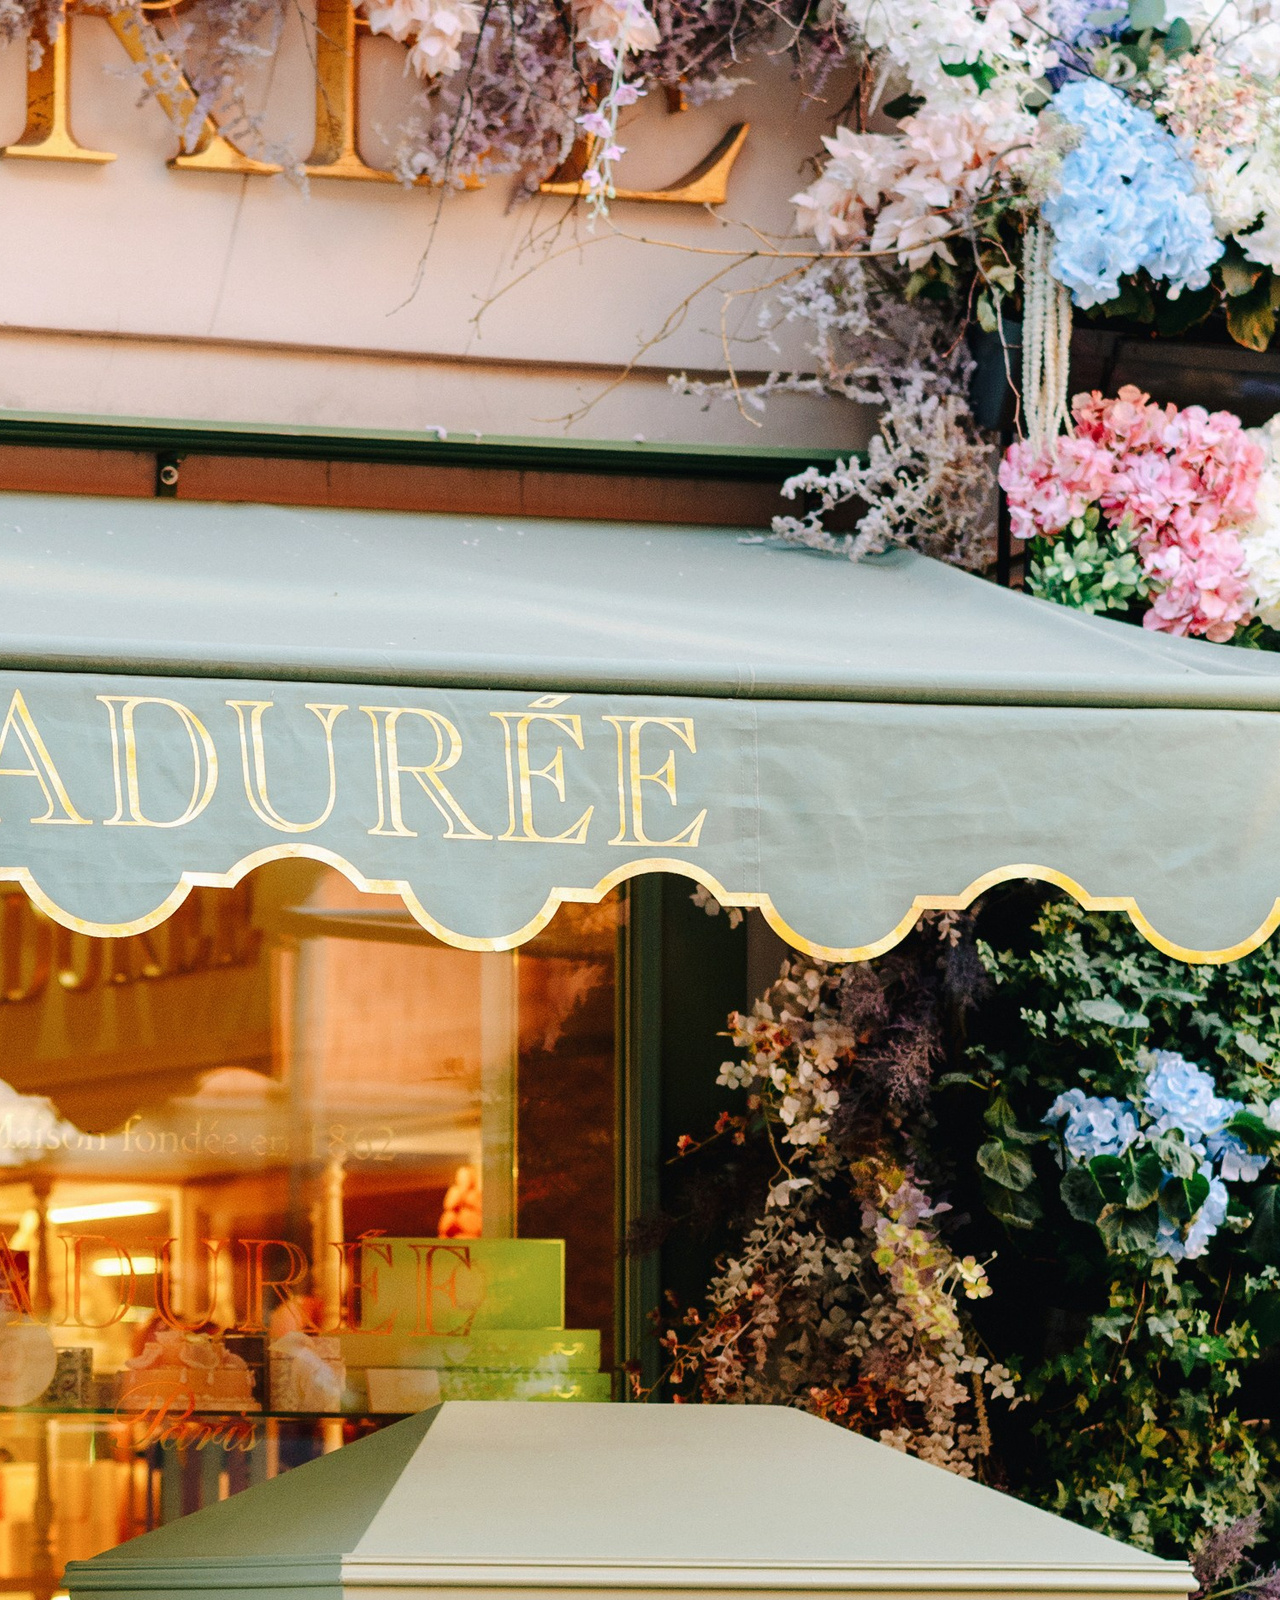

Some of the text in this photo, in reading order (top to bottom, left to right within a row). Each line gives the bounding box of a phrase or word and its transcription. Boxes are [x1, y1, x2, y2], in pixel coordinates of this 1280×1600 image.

[122, 1114, 239, 1156] fondée
[250, 1136, 290, 1158] en
[312, 1123, 397, 1163] 1862
[112, 1381, 263, 1453] Paris
